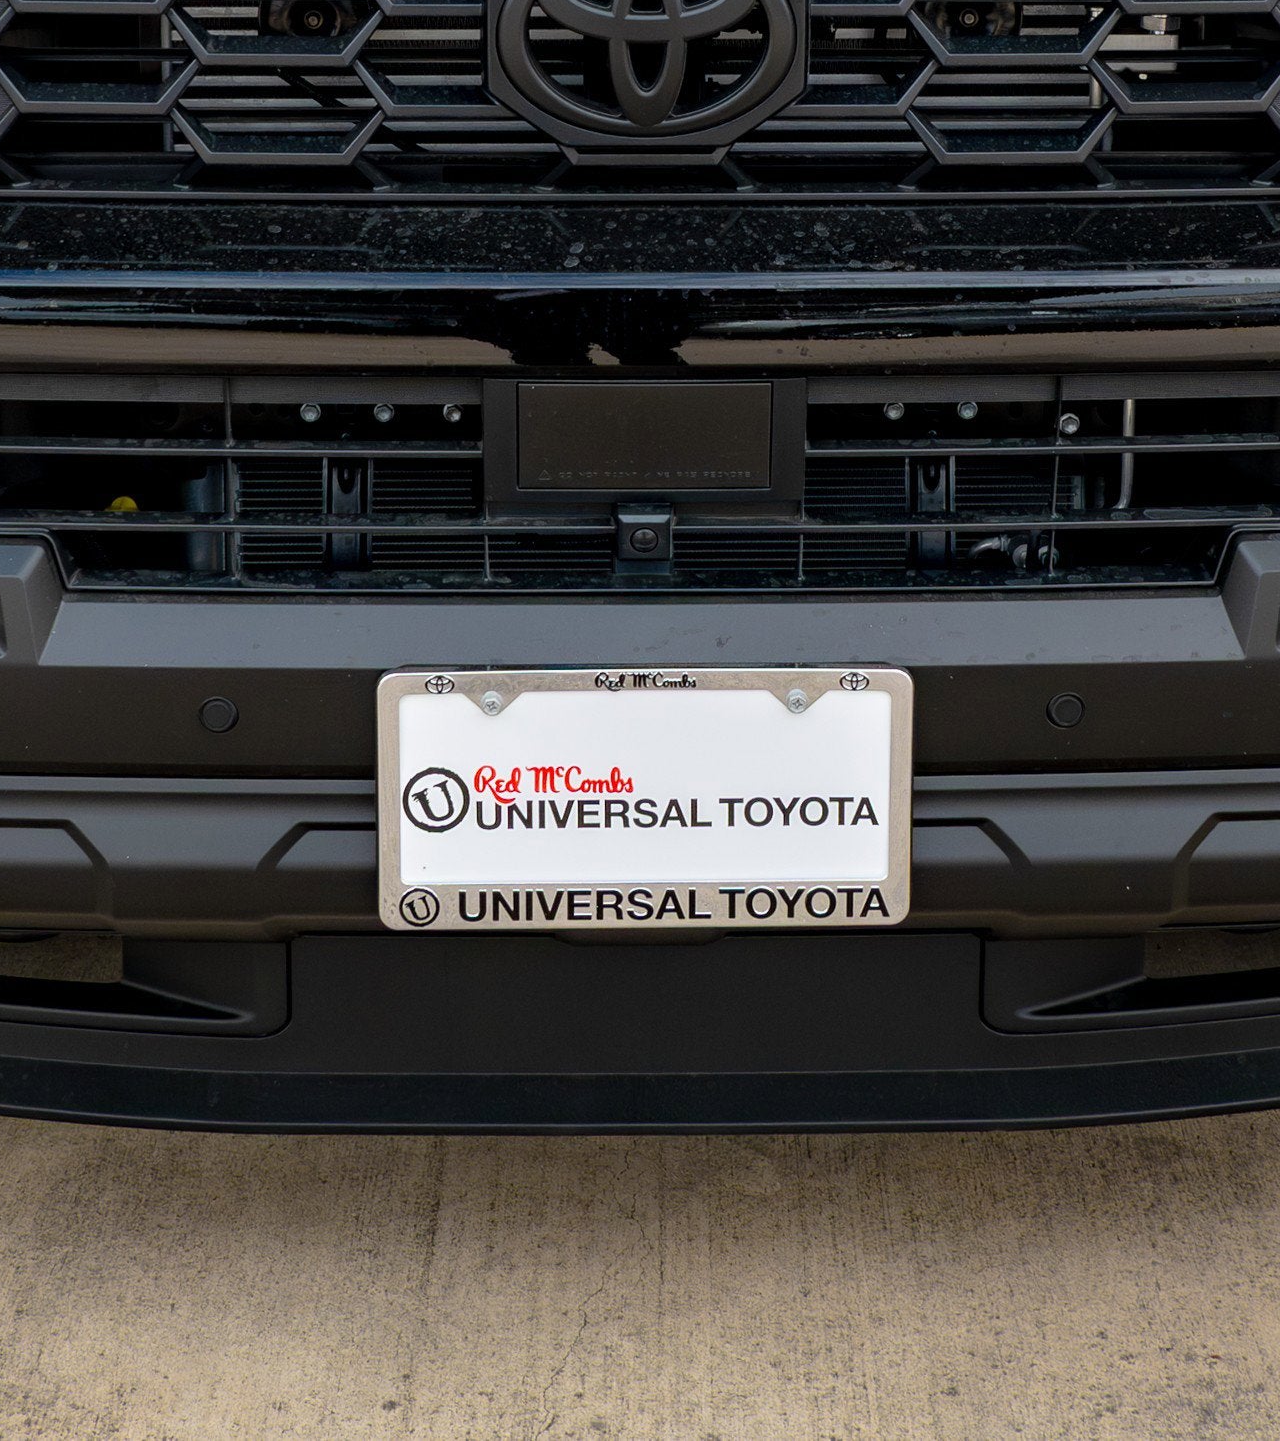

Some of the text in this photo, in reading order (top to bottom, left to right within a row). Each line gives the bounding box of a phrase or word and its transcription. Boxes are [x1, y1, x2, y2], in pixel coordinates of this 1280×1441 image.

[594, 671, 698, 692] Red McCombs
[473, 764, 634, 805] Red McCombs
[475, 795, 880, 831] UNIVERSAL TOYOTA
[458, 887, 711, 922] UNIVERSAL
[719, 886, 891, 920] TOYOTA
